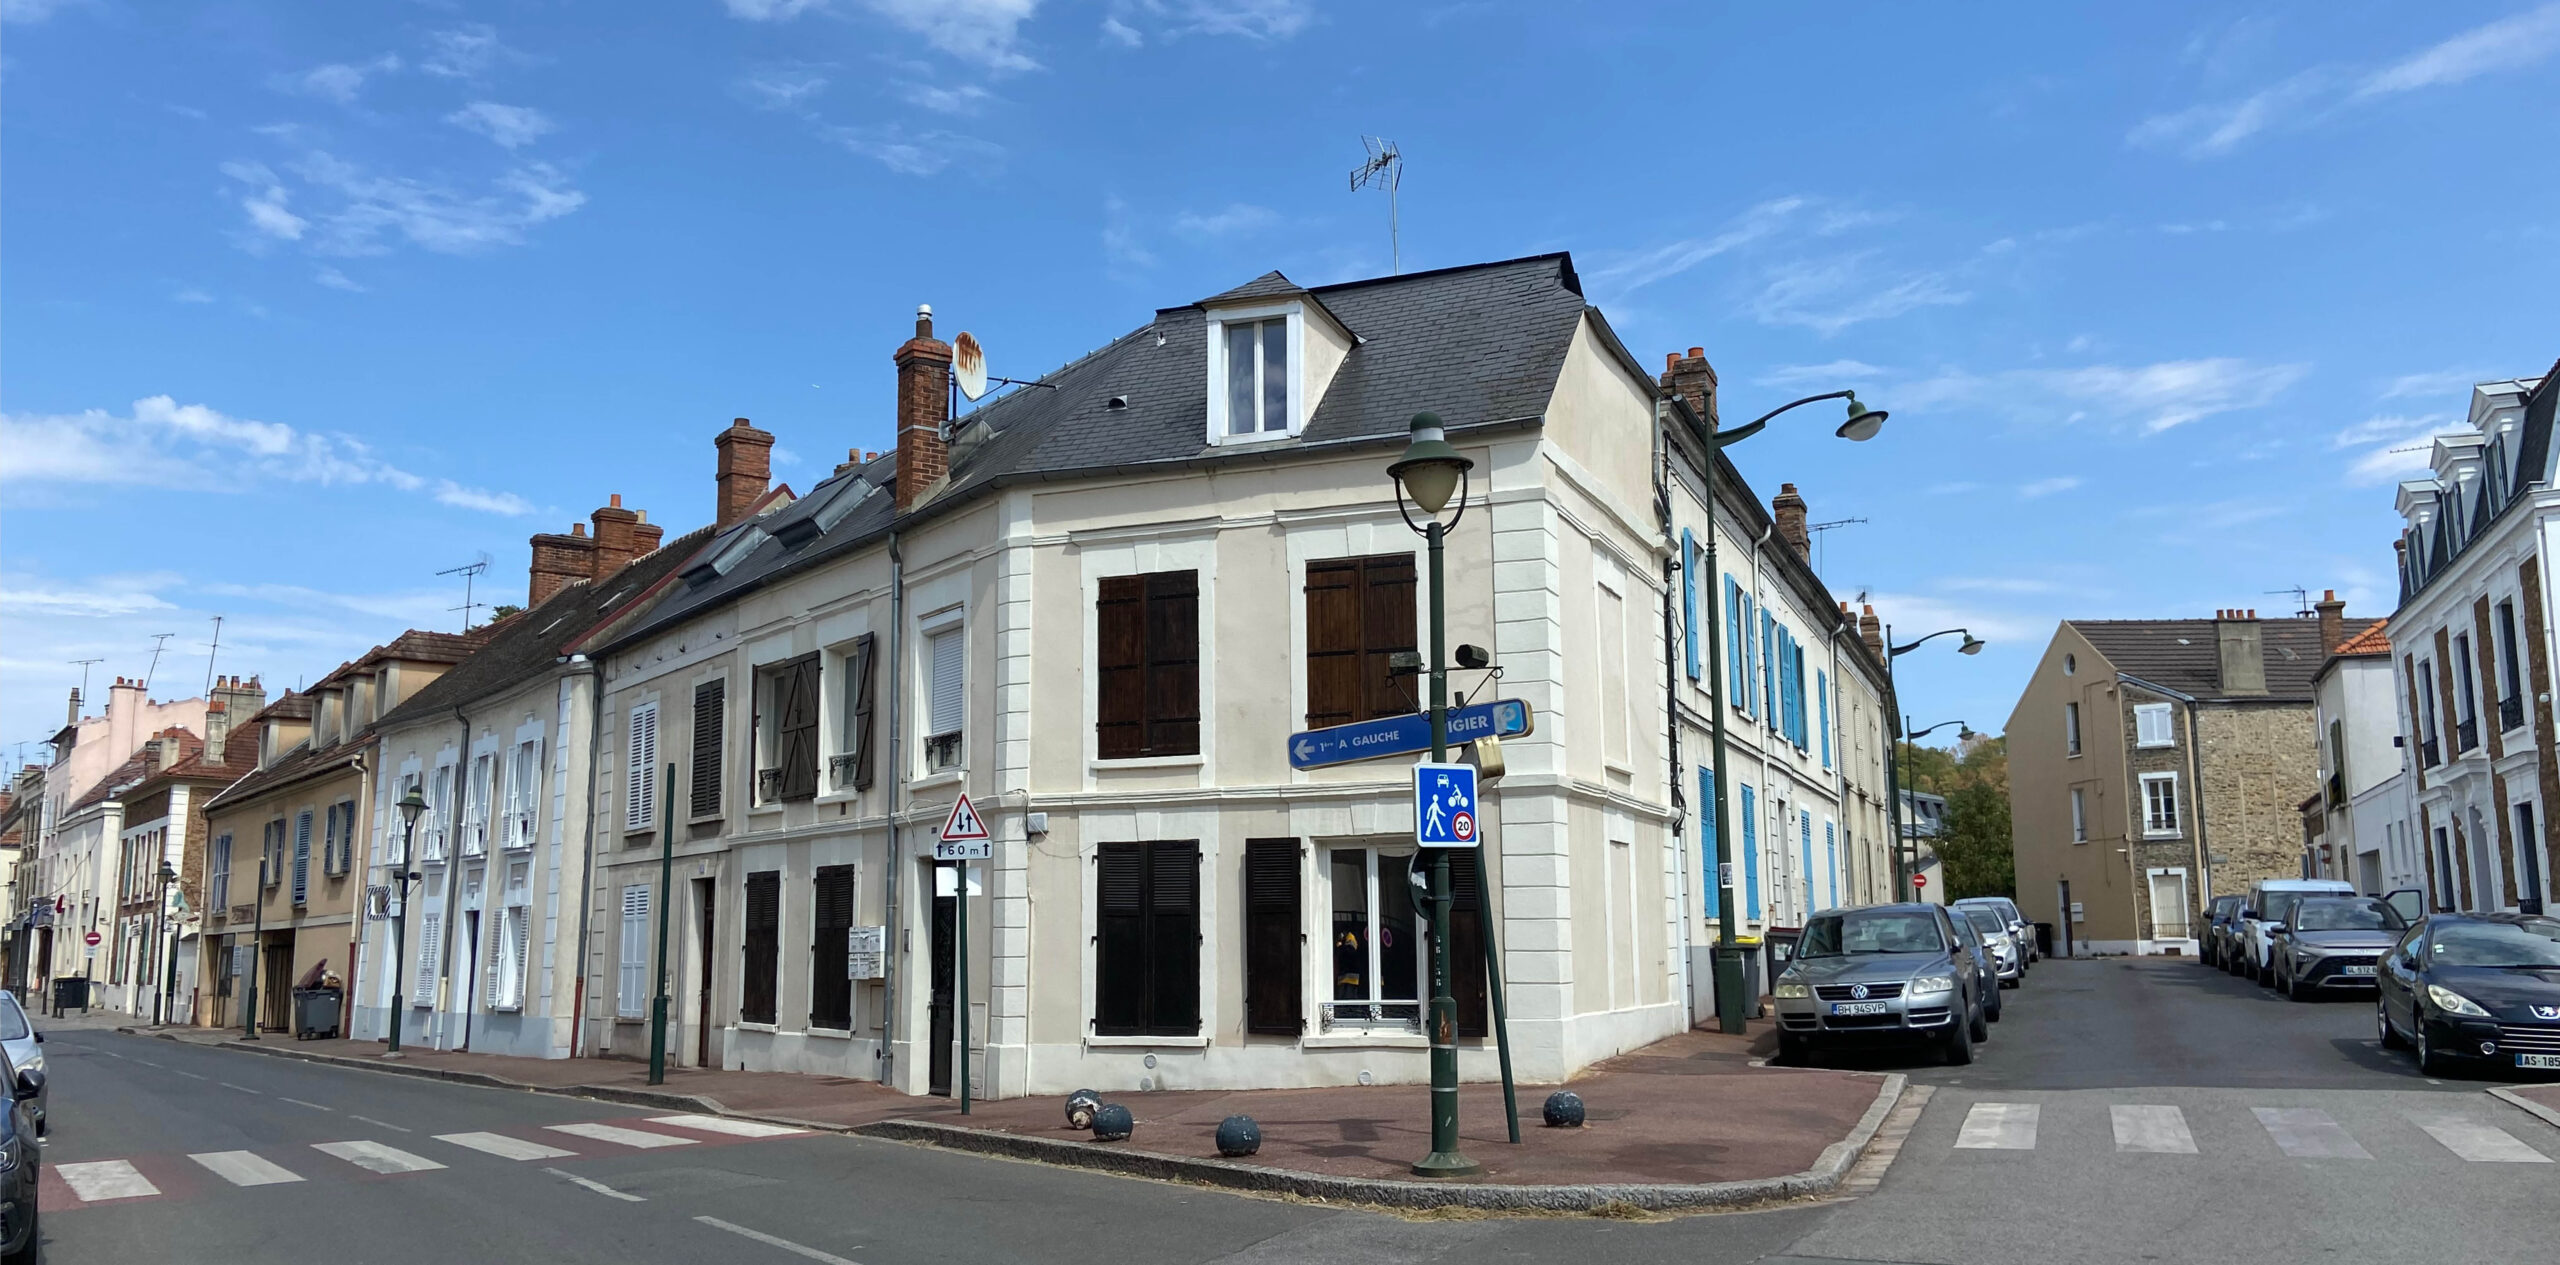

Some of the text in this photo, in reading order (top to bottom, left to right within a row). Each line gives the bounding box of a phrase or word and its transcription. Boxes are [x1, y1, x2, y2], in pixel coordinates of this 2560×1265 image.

[1338, 739, 1348, 749] A
[1352, 730, 1400, 746] GAUCHE
[1447, 715, 1489, 733] IGIER
[1457, 821, 1470, 831] 20
[947, 845, 965, 855] 60
